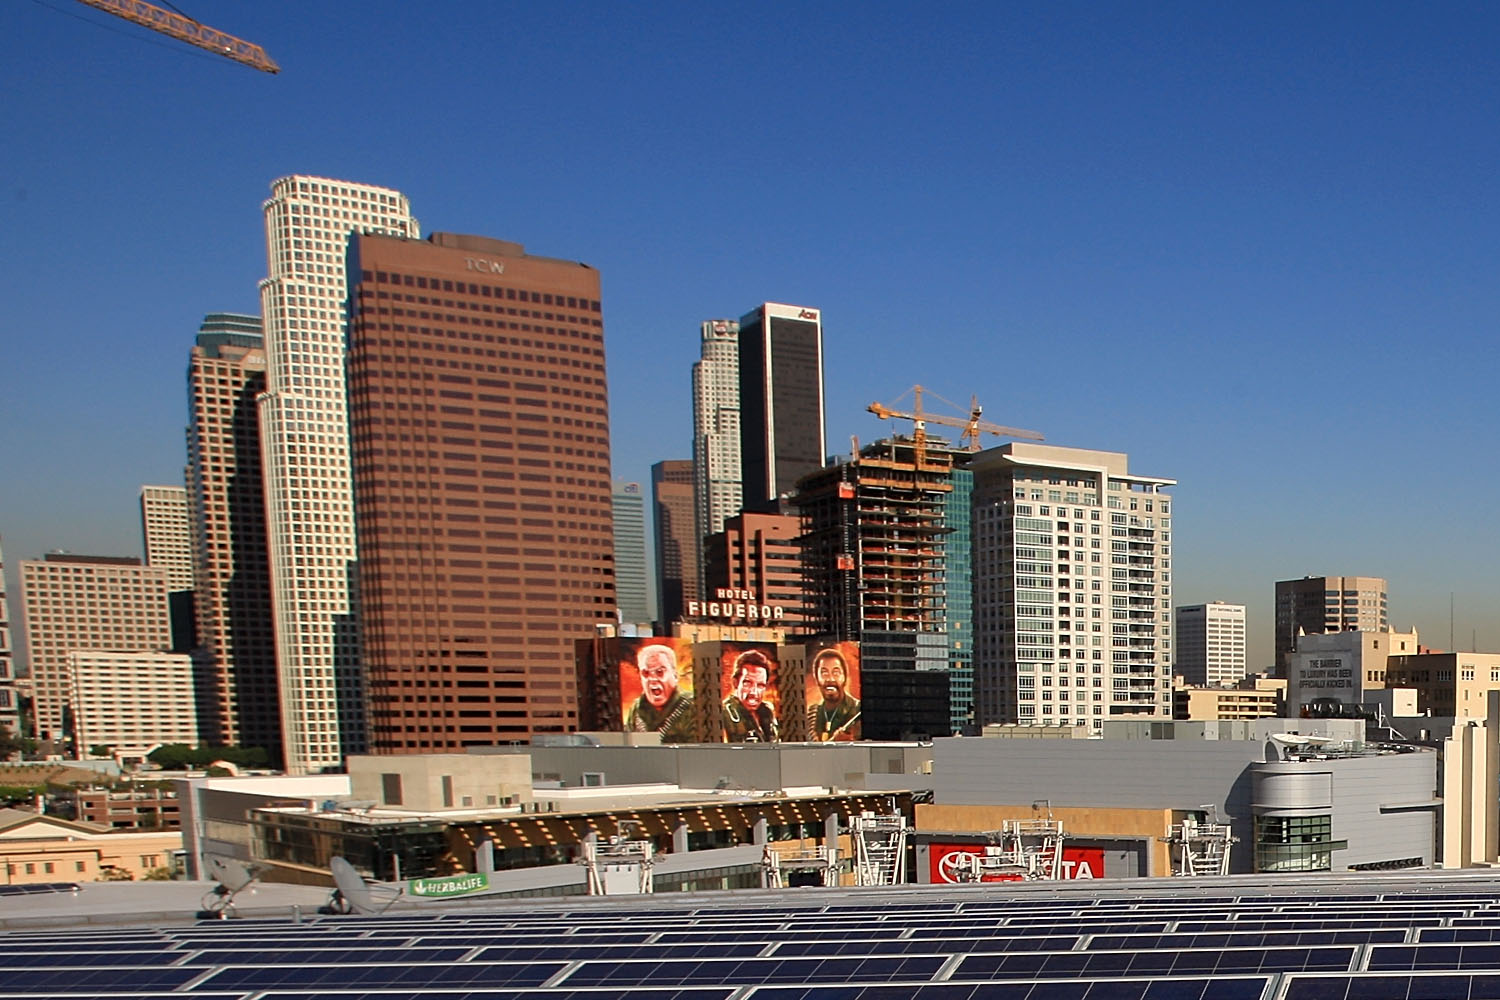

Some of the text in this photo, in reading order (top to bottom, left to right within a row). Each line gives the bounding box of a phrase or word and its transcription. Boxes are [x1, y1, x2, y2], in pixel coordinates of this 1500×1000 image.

[464, 257, 505, 274] TCW
[717, 588, 756, 600] HOTEL
[688, 601, 784, 619] FIGUEROA
[1309, 660, 1319, 668] THE
[427, 877, 483, 893] HERBALIFE
